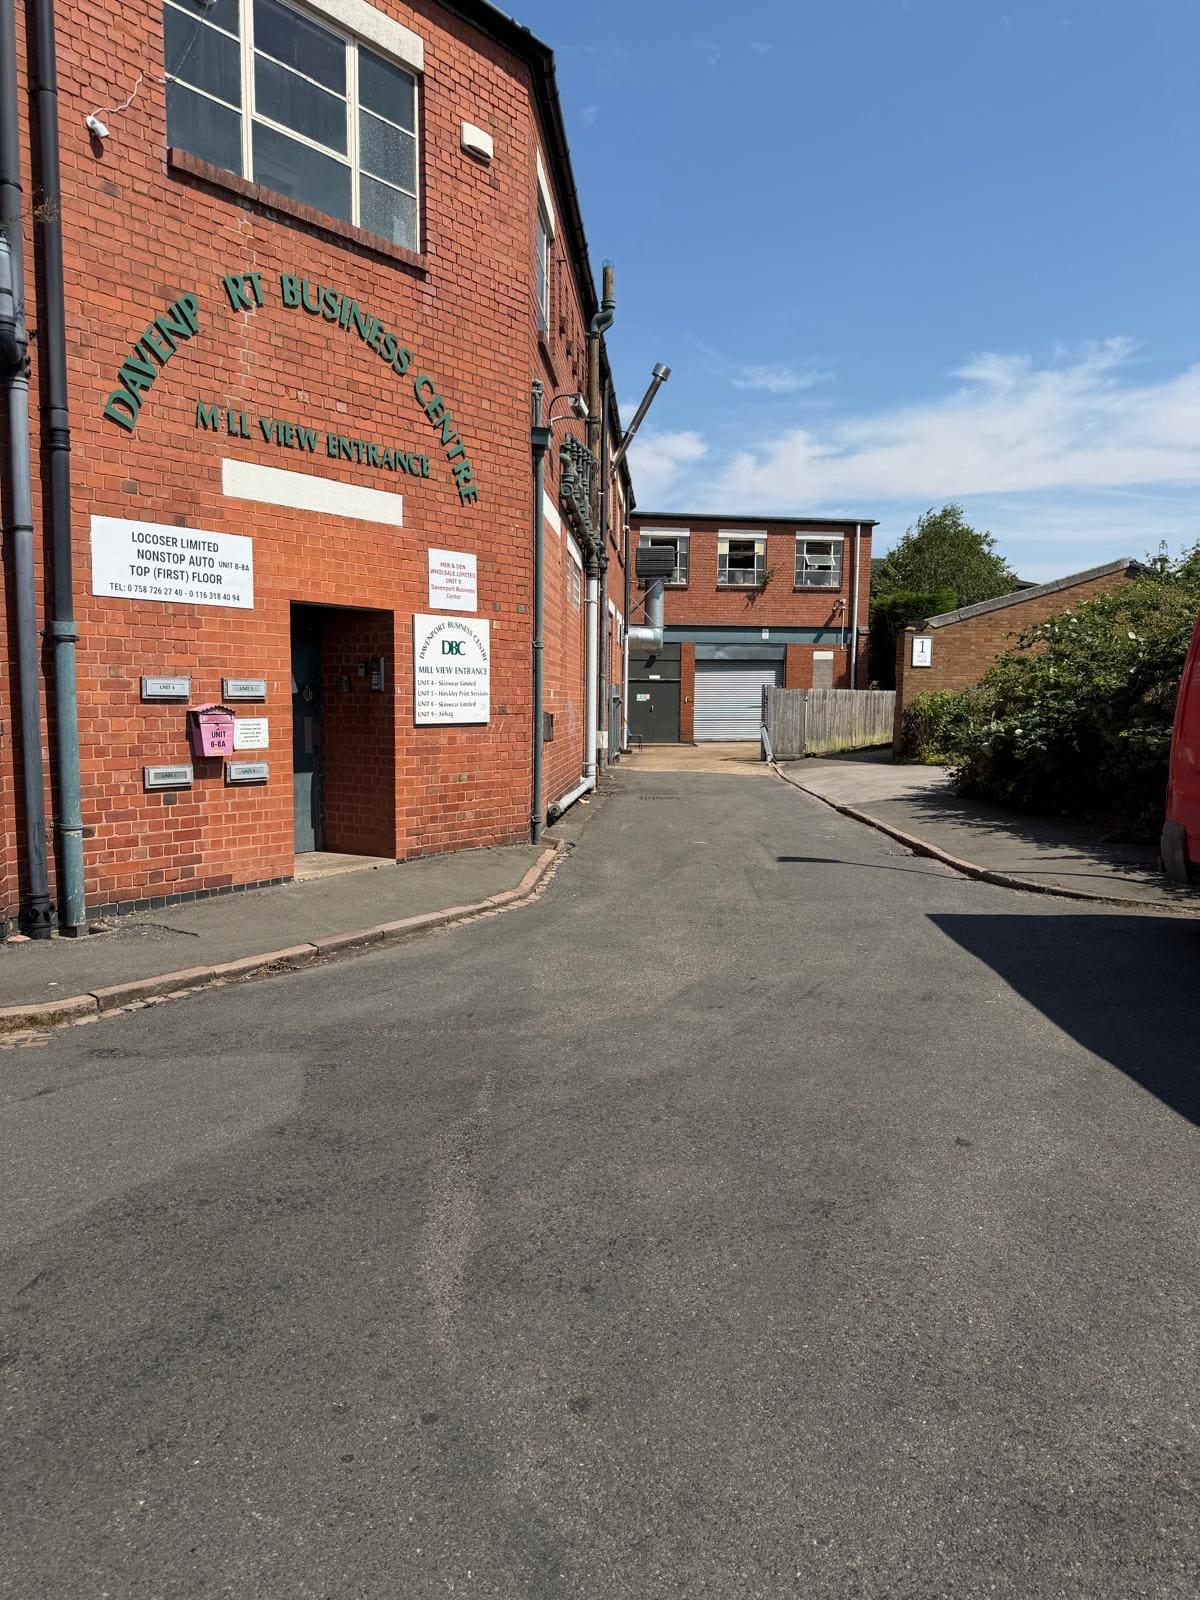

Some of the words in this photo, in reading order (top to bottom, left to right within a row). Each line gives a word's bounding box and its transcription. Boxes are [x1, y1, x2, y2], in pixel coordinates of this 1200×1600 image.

[280, 273, 414, 377] BUSINESS
[414, 374, 479, 507] CENTRE
[258, 416, 321, 452] VIEW
[326, 433, 430, 478] ENTRANCE
[131, 531, 178, 548] LOCOSER
[181, 538, 219, 553] LIMITED
[137, 549, 186, 565] NONSTOP
[189, 555, 215, 569] AUTO
[218, 561, 233, 569] UNIT
[129, 565, 150, 577] TOP
[154, 567, 189, 583] (FIRST)
[192, 572, 222, 585] FLOOR
[110, 582, 126, 591] TEL:
[127, 584, 132, 592] 0
[134, 584, 147, 593] 758
[149, 586, 162, 595] 726
[164, 587, 172, 595] 27
[174, 588, 183, 596] 40
[195, 591, 207, 599] 116
[222, 592, 230, 601] 40
[232, 594, 240, 602] 94
[419, 622, 446, 659] DAVENPORT
[447, 621, 473, 636] BUSINESS
[473, 634, 487, 661] CENTRE
[442, 640, 466, 656] DBC
[920, 641, 925, 653] 1
[418, 666, 434, 674] MILL
[435, 666, 453, 674] VIEW
[455, 667, 487, 675] ENTRANCE
